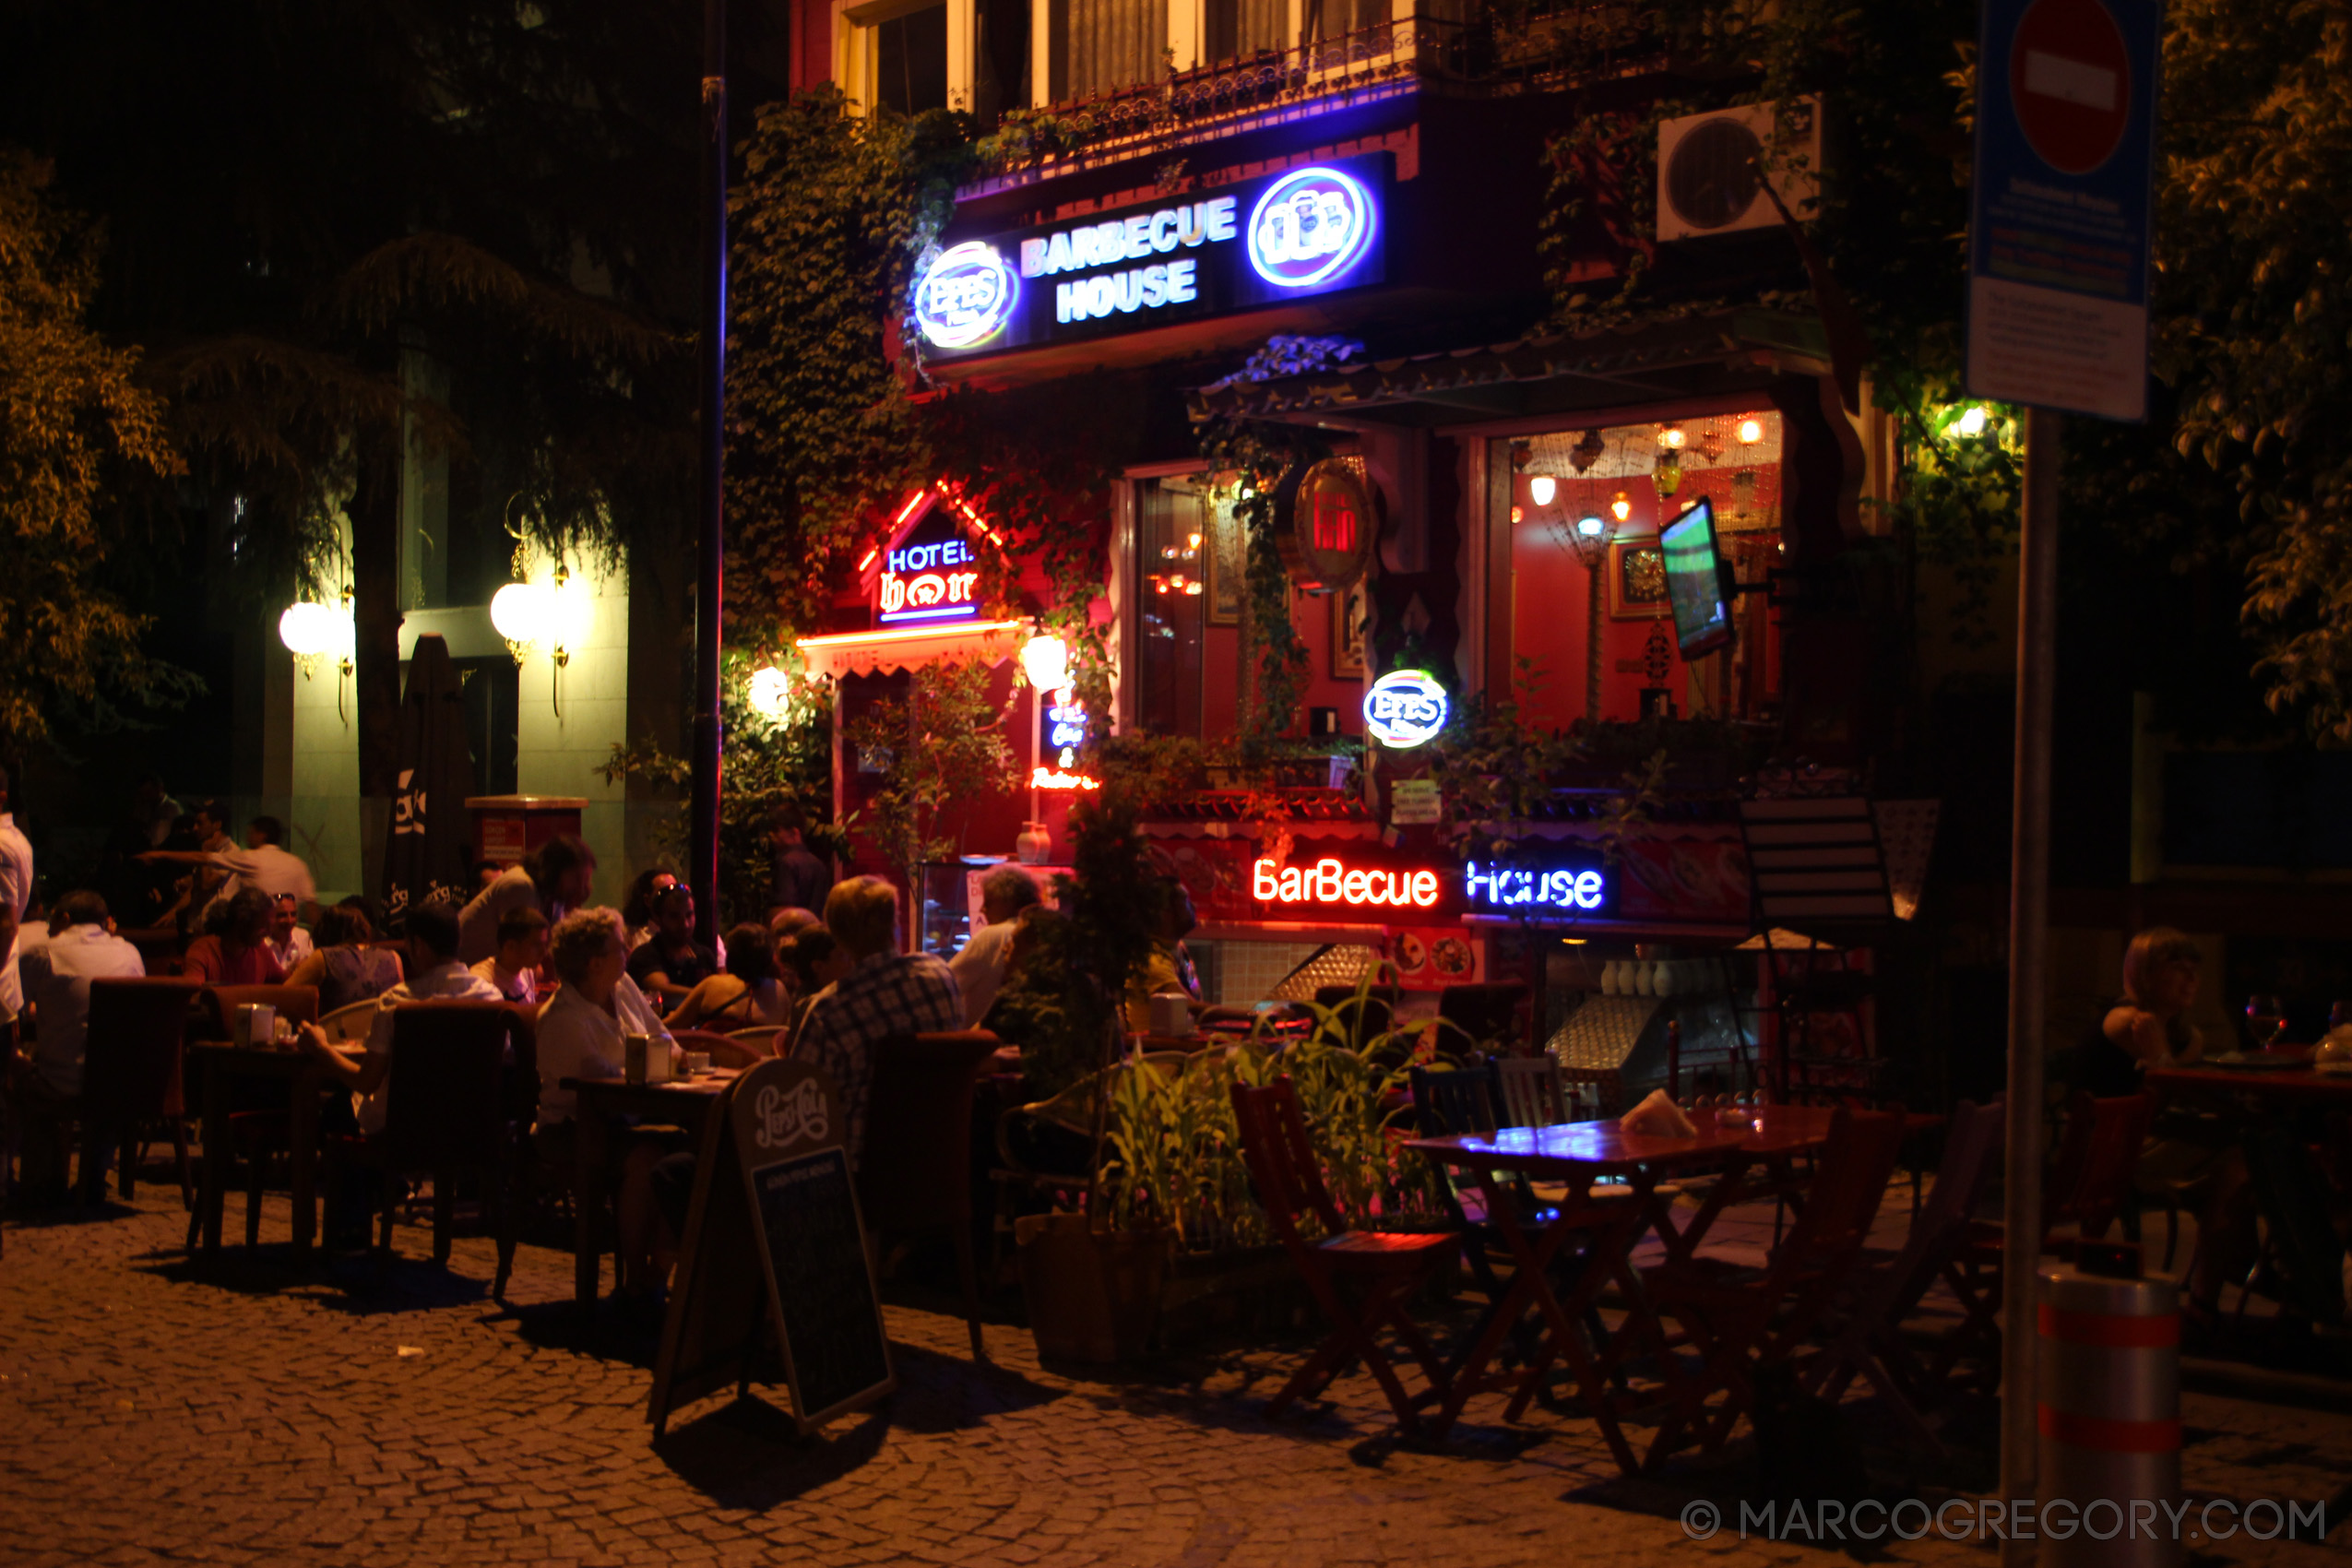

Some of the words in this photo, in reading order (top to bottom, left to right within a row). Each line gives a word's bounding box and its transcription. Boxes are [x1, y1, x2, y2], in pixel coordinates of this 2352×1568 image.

[1020, 195, 1239, 278] BARBECUE
[1056, 258, 1197, 324] HOUSE
[888, 540, 975, 573] HOTEL
[1253, 858, 1439, 908] BarBecue
[1466, 859, 1605, 909] House
